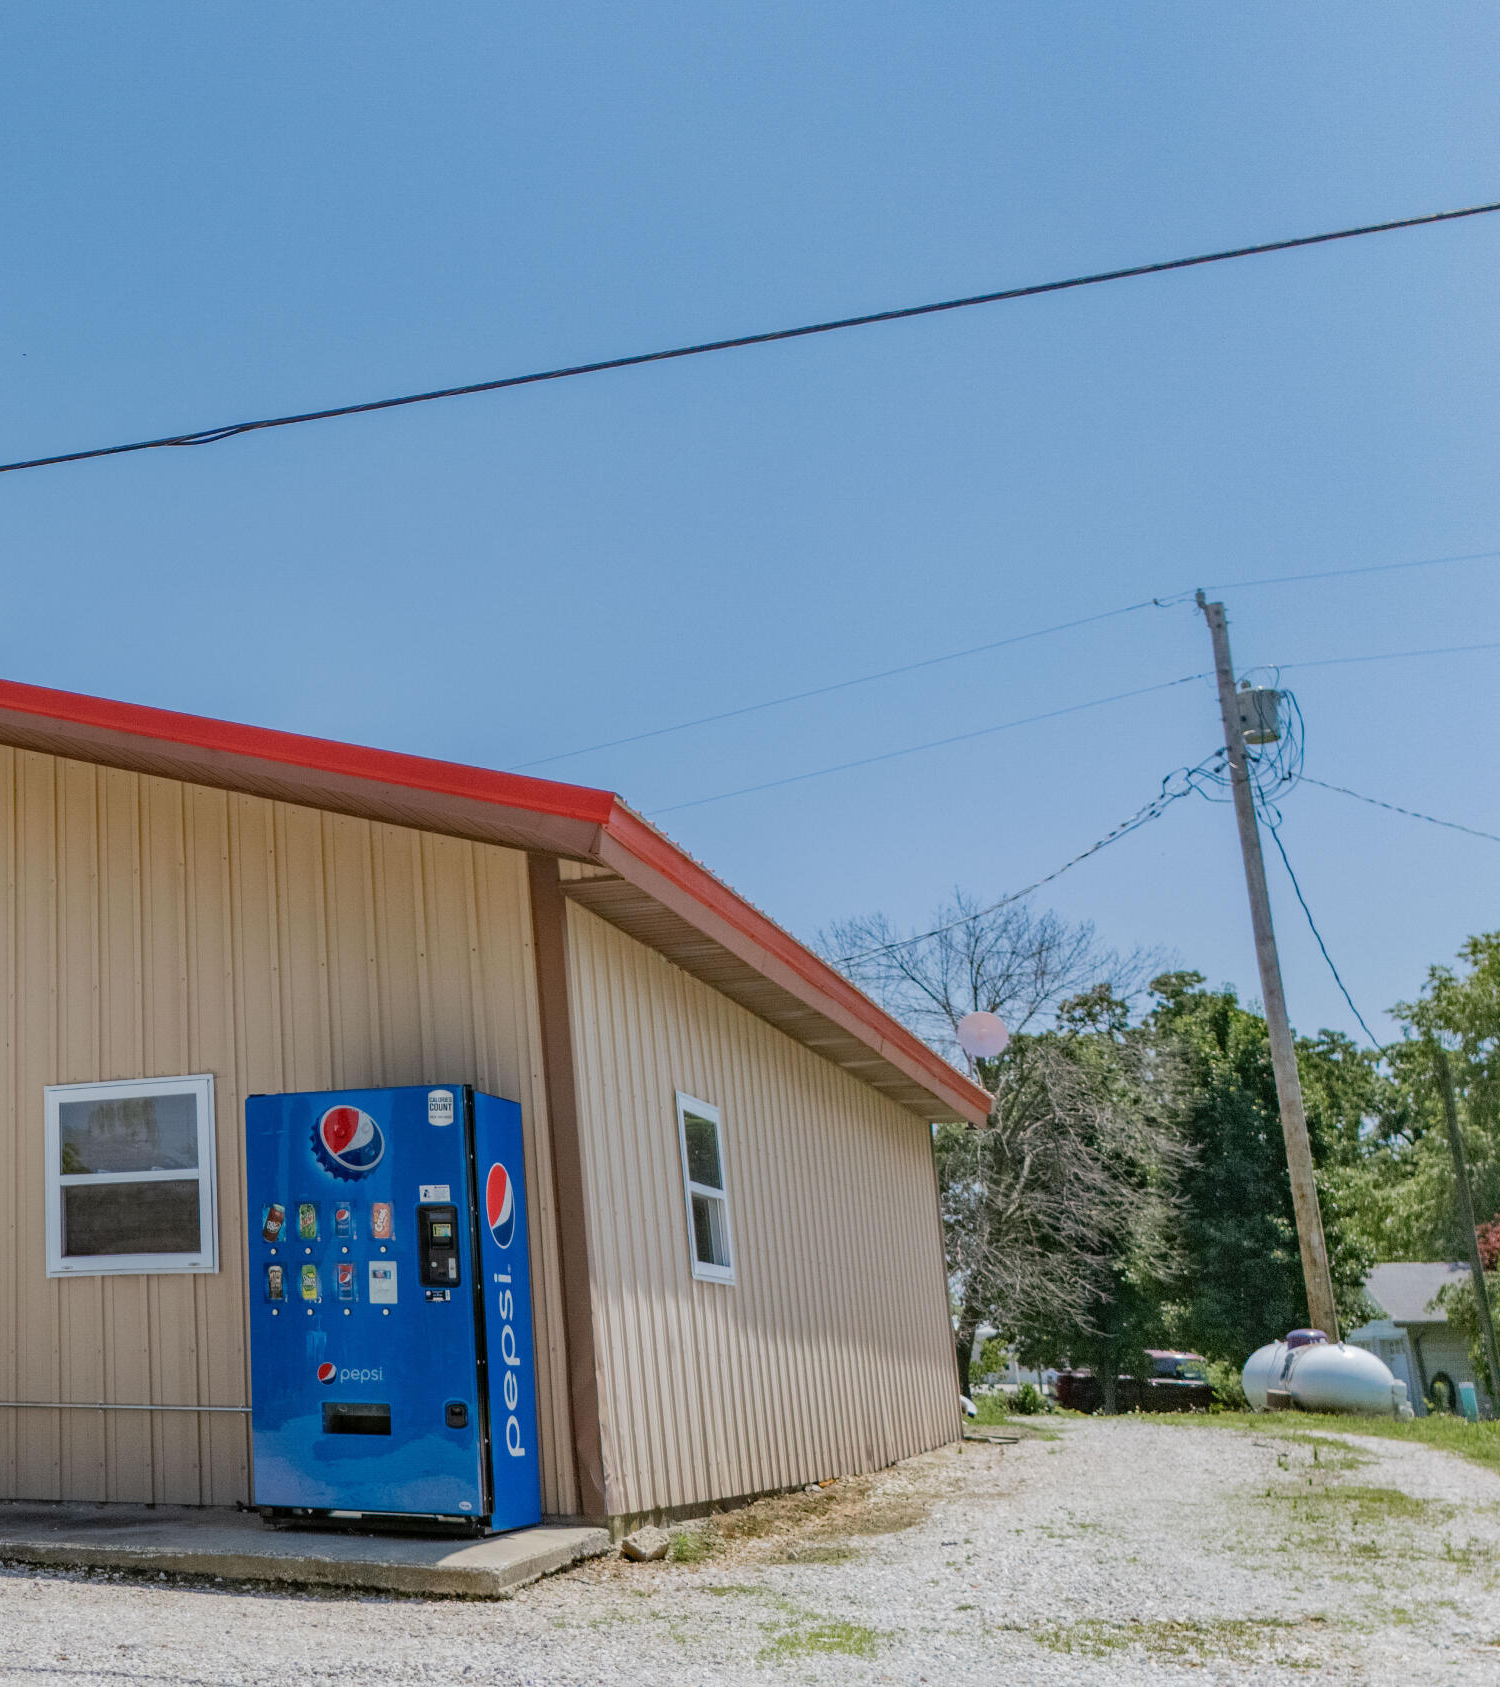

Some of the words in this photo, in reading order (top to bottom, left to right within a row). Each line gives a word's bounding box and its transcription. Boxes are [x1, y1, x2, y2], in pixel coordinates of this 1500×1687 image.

[429, 1103, 453, 1112] COUNT
[494, 1273, 526, 1457] pepsi
[340, 1366, 383, 1384] pepsi
